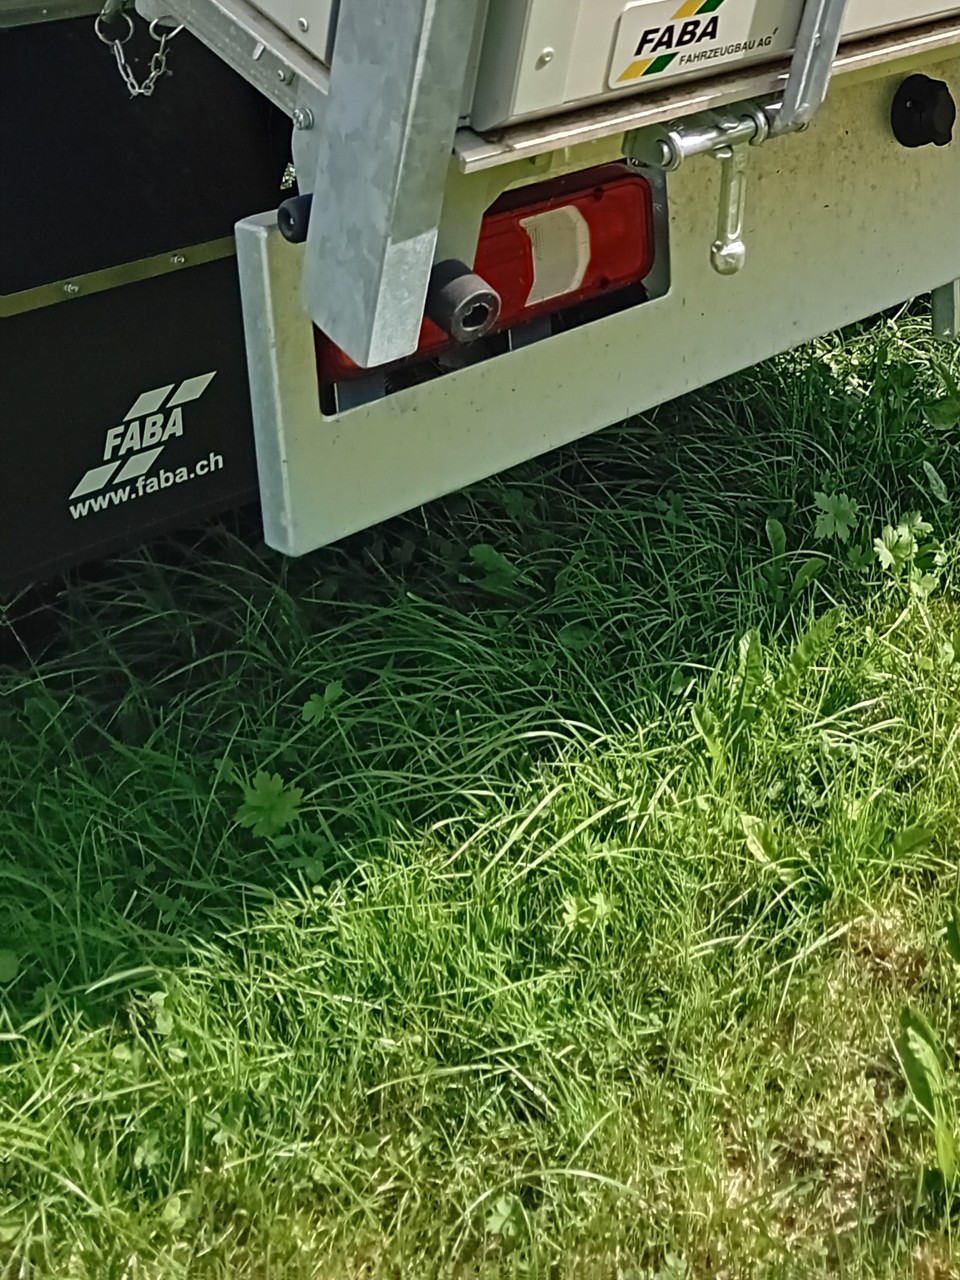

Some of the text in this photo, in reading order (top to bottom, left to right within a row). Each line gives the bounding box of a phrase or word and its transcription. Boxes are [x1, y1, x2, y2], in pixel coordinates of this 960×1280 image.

[635, 15, 719, 57] FABA
[679, 36, 772, 65] FAHRZEUGBAU AG
[103, 406, 183, 461] FABA
[69, 452, 224, 520] www.faba.ch
